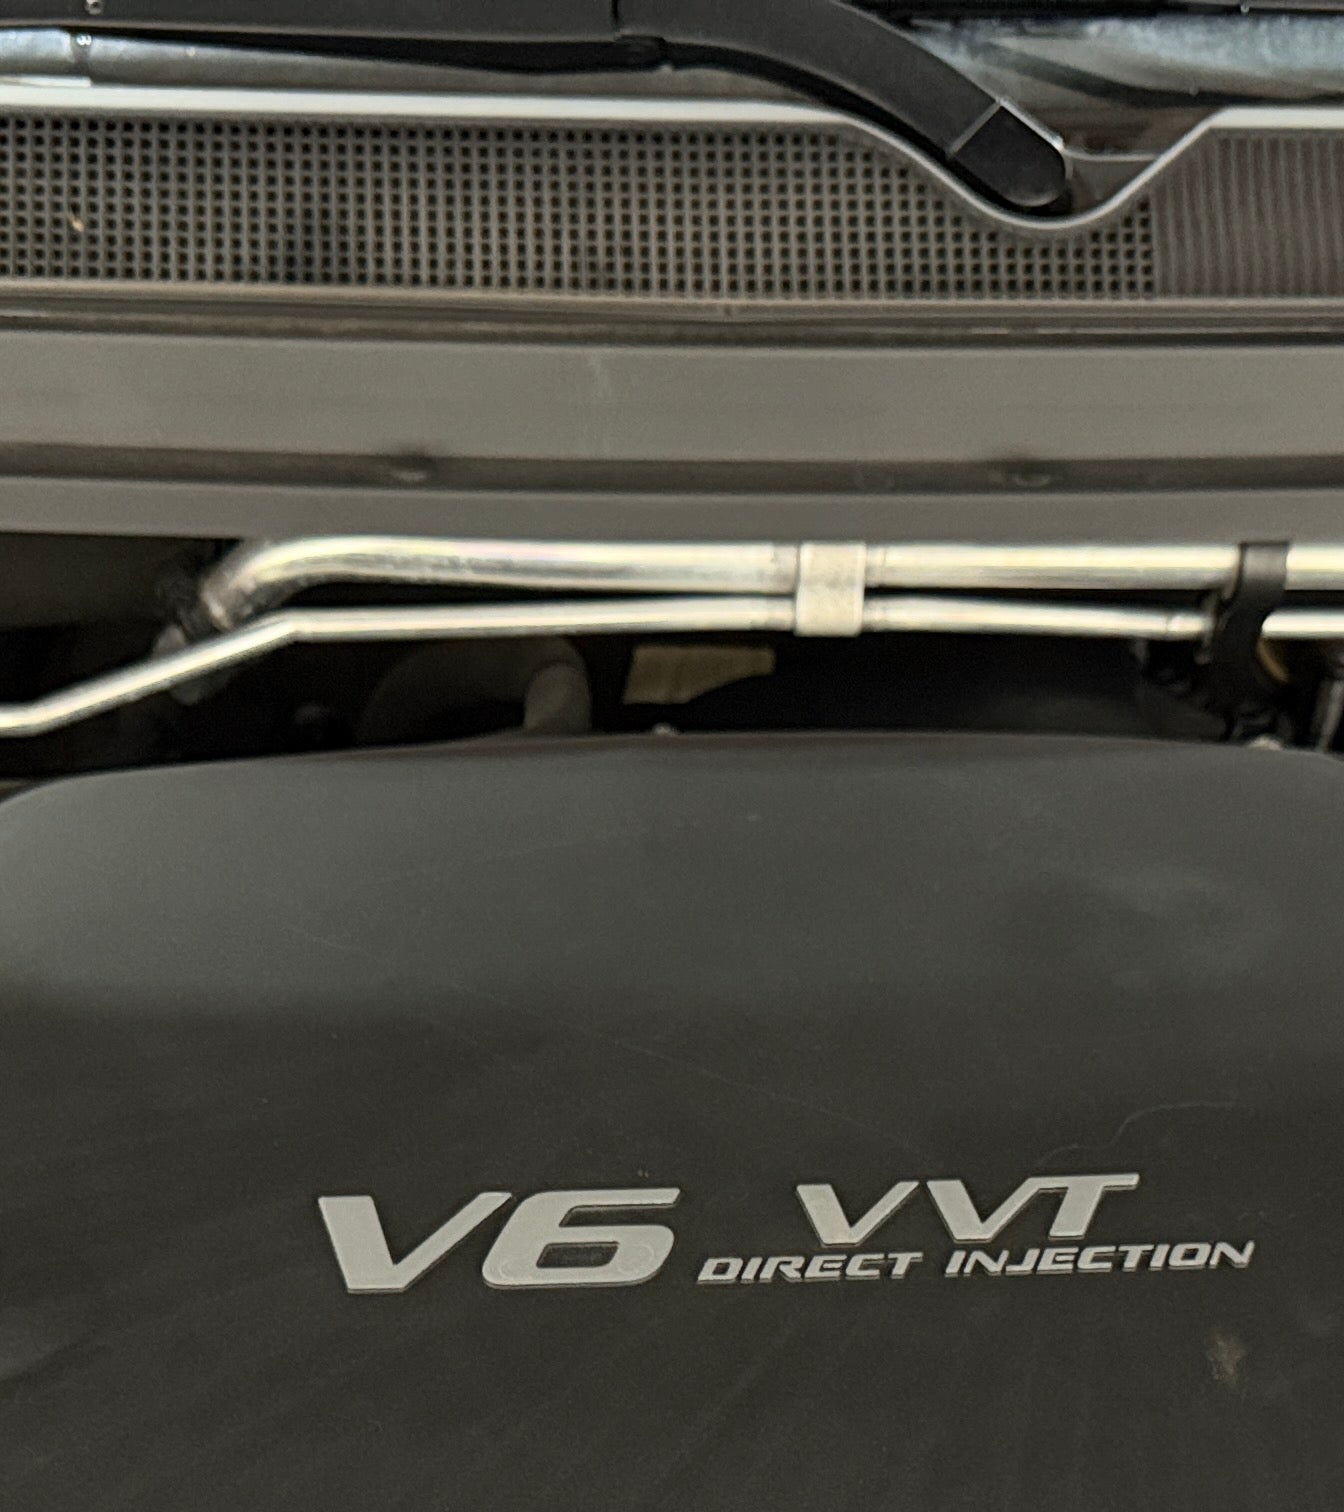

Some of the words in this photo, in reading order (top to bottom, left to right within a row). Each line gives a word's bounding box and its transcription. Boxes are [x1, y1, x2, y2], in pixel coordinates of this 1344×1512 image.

[317, 1187, 681, 1293] V6
[796, 1173, 1140, 1247] VVT
[696, 1251, 924, 1285] DIRECT
[944, 1240, 1256, 1278] INJECTION
